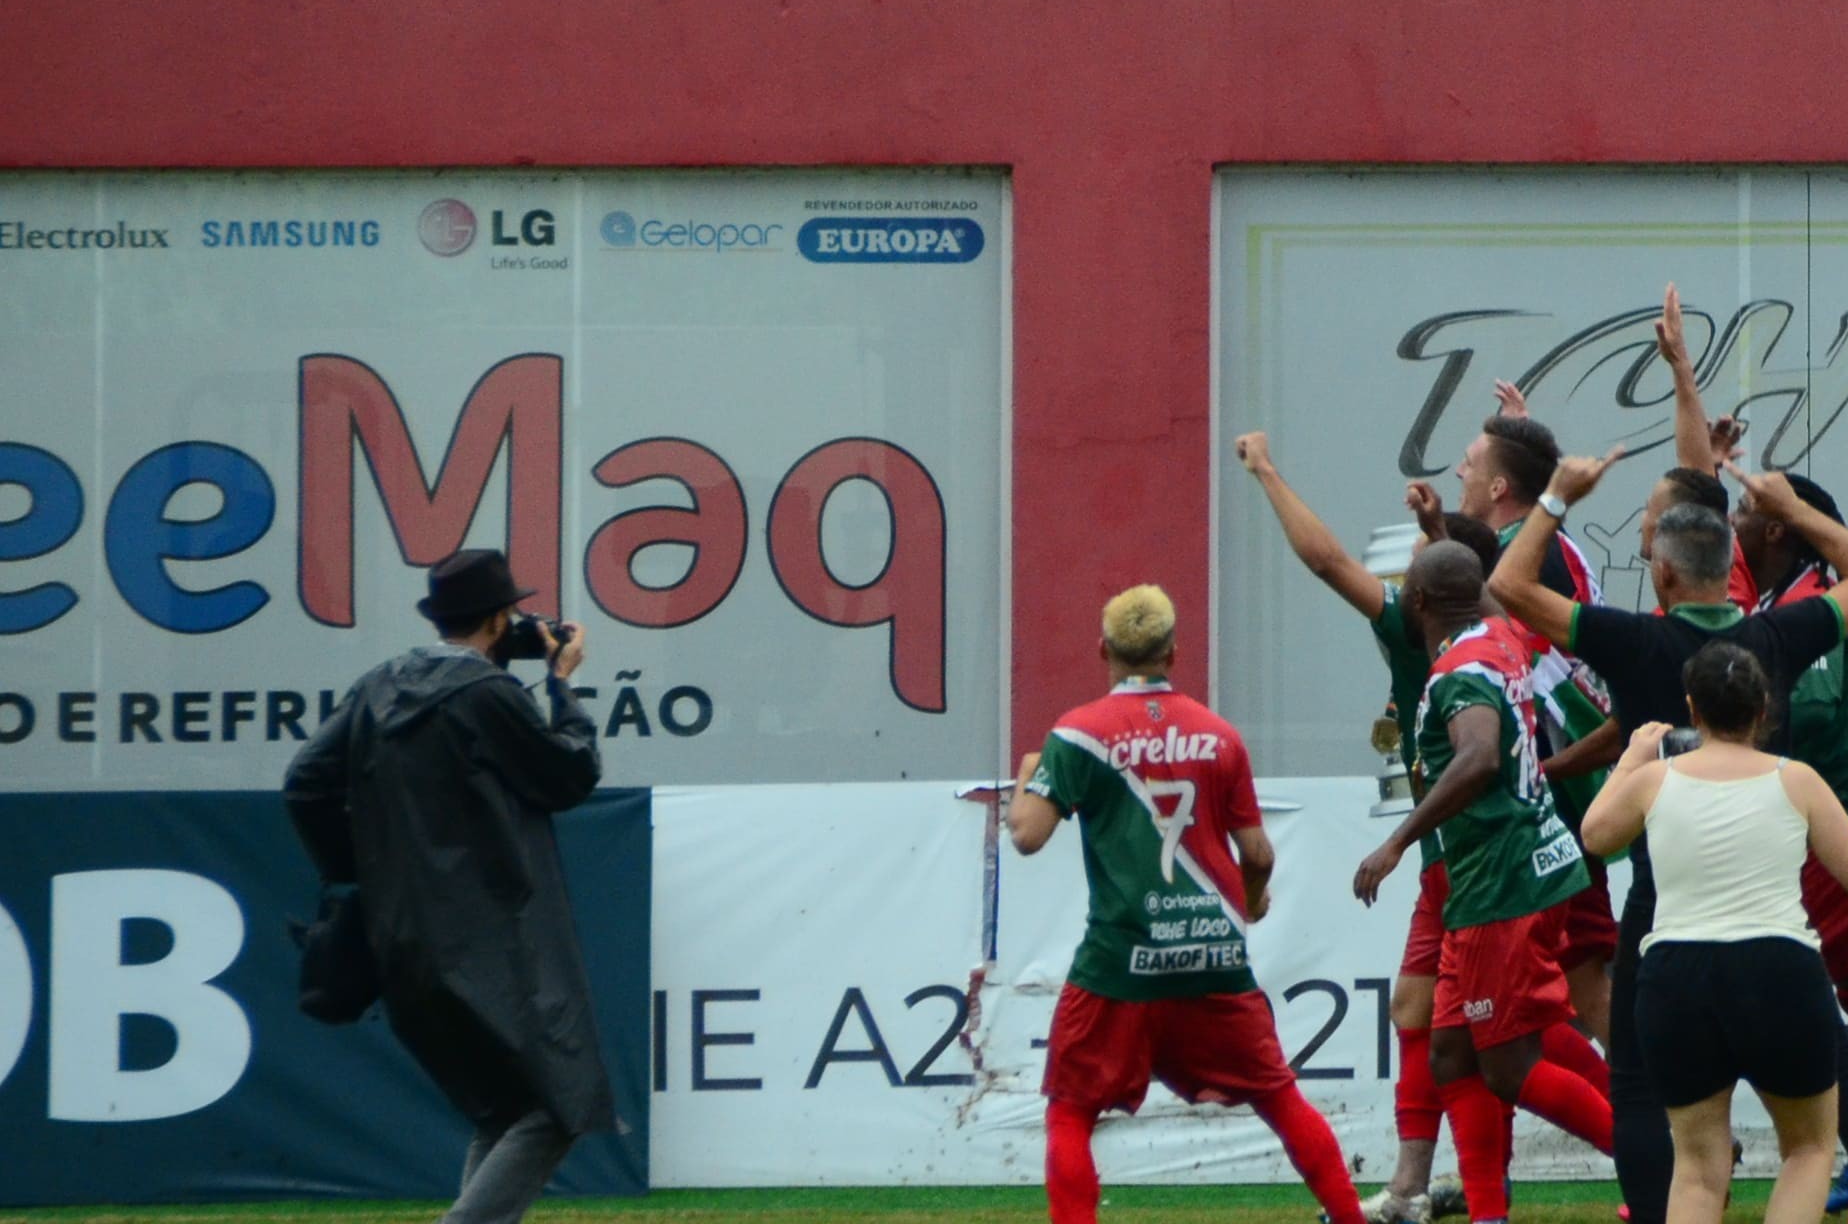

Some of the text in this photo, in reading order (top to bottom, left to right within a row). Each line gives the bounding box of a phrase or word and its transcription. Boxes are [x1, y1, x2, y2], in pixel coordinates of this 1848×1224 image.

[804, 199, 979, 212] REVENDEDOR AUTORIZADO
[0, 208, 784, 254] Electrolux SAMSUNG LG Gelopar
[491, 256, 569, 272] Life's Good
[58, 692, 98, 744] E
[1109, 725, 1218, 771] creluz
[1144, 776, 1197, 884] 7
[804, 984, 975, 1089] A2
